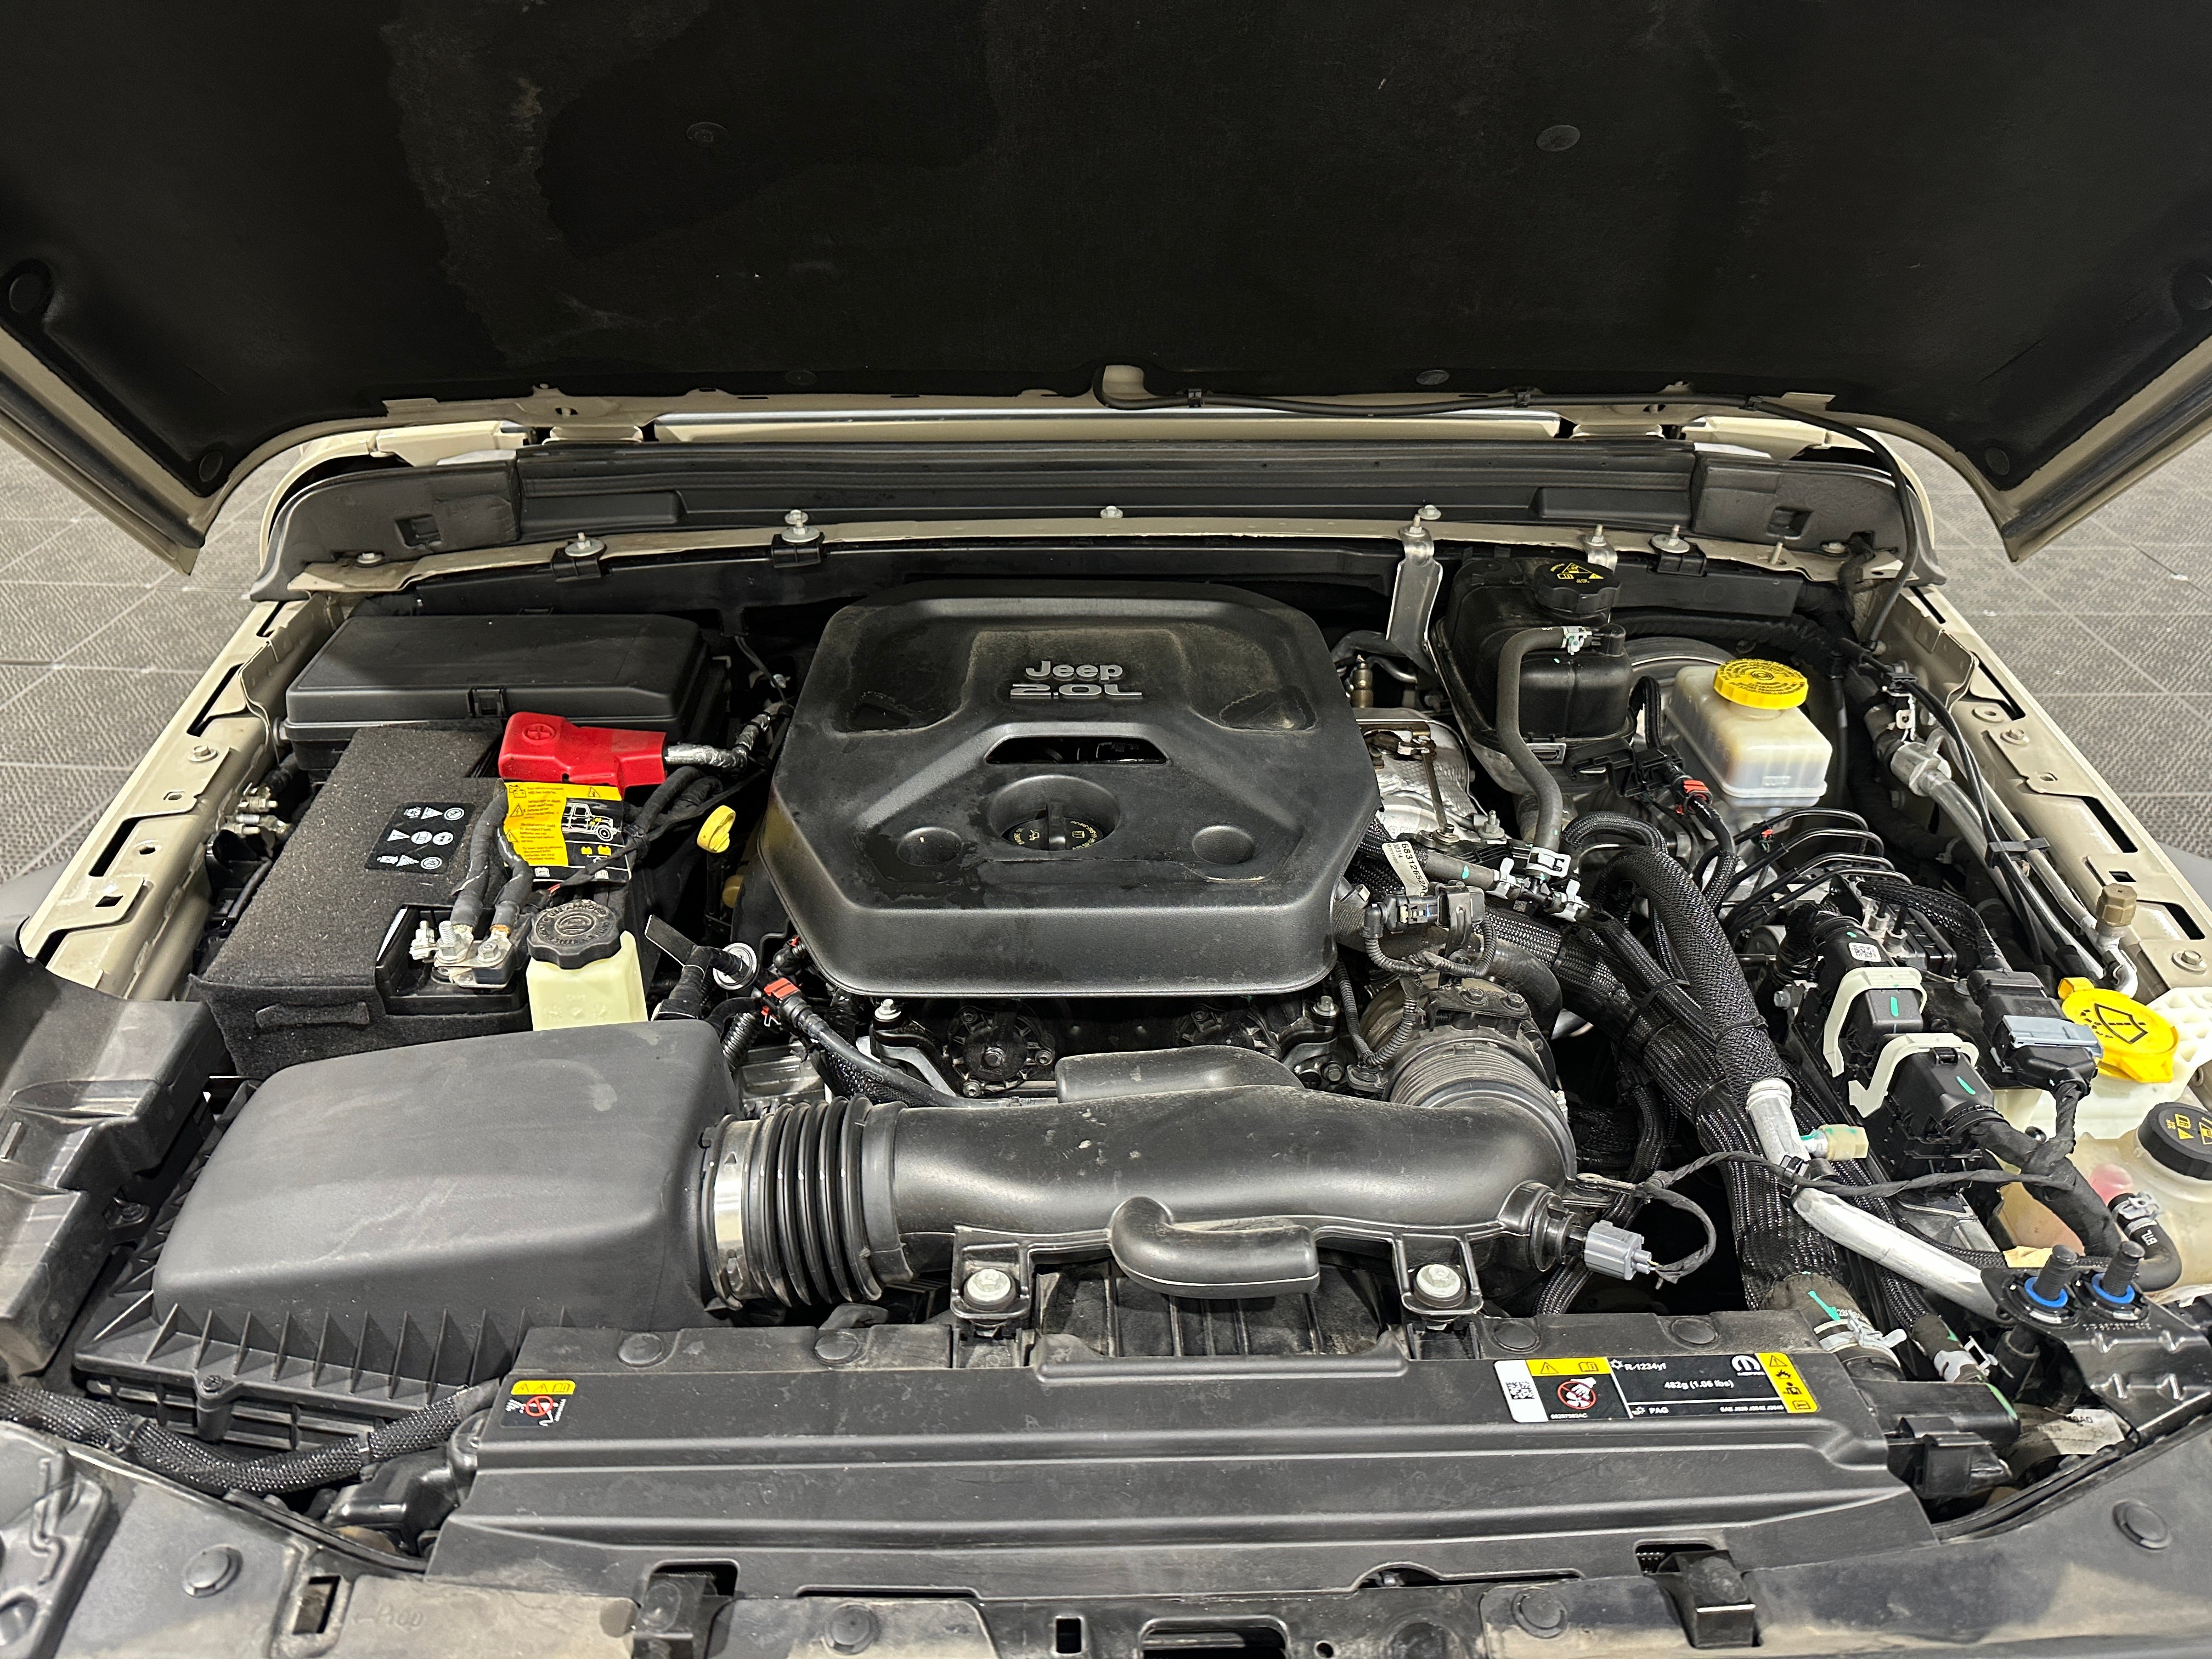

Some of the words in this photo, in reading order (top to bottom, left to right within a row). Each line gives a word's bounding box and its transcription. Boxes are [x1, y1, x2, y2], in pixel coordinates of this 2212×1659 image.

[1025, 660, 1123, 683] Jeep
[1010, 684, 1143, 699] 2.0L
[1623, 1362, 1667, 1371] R-1234yf
[1714, 1379, 1734, 1389] lbs)
